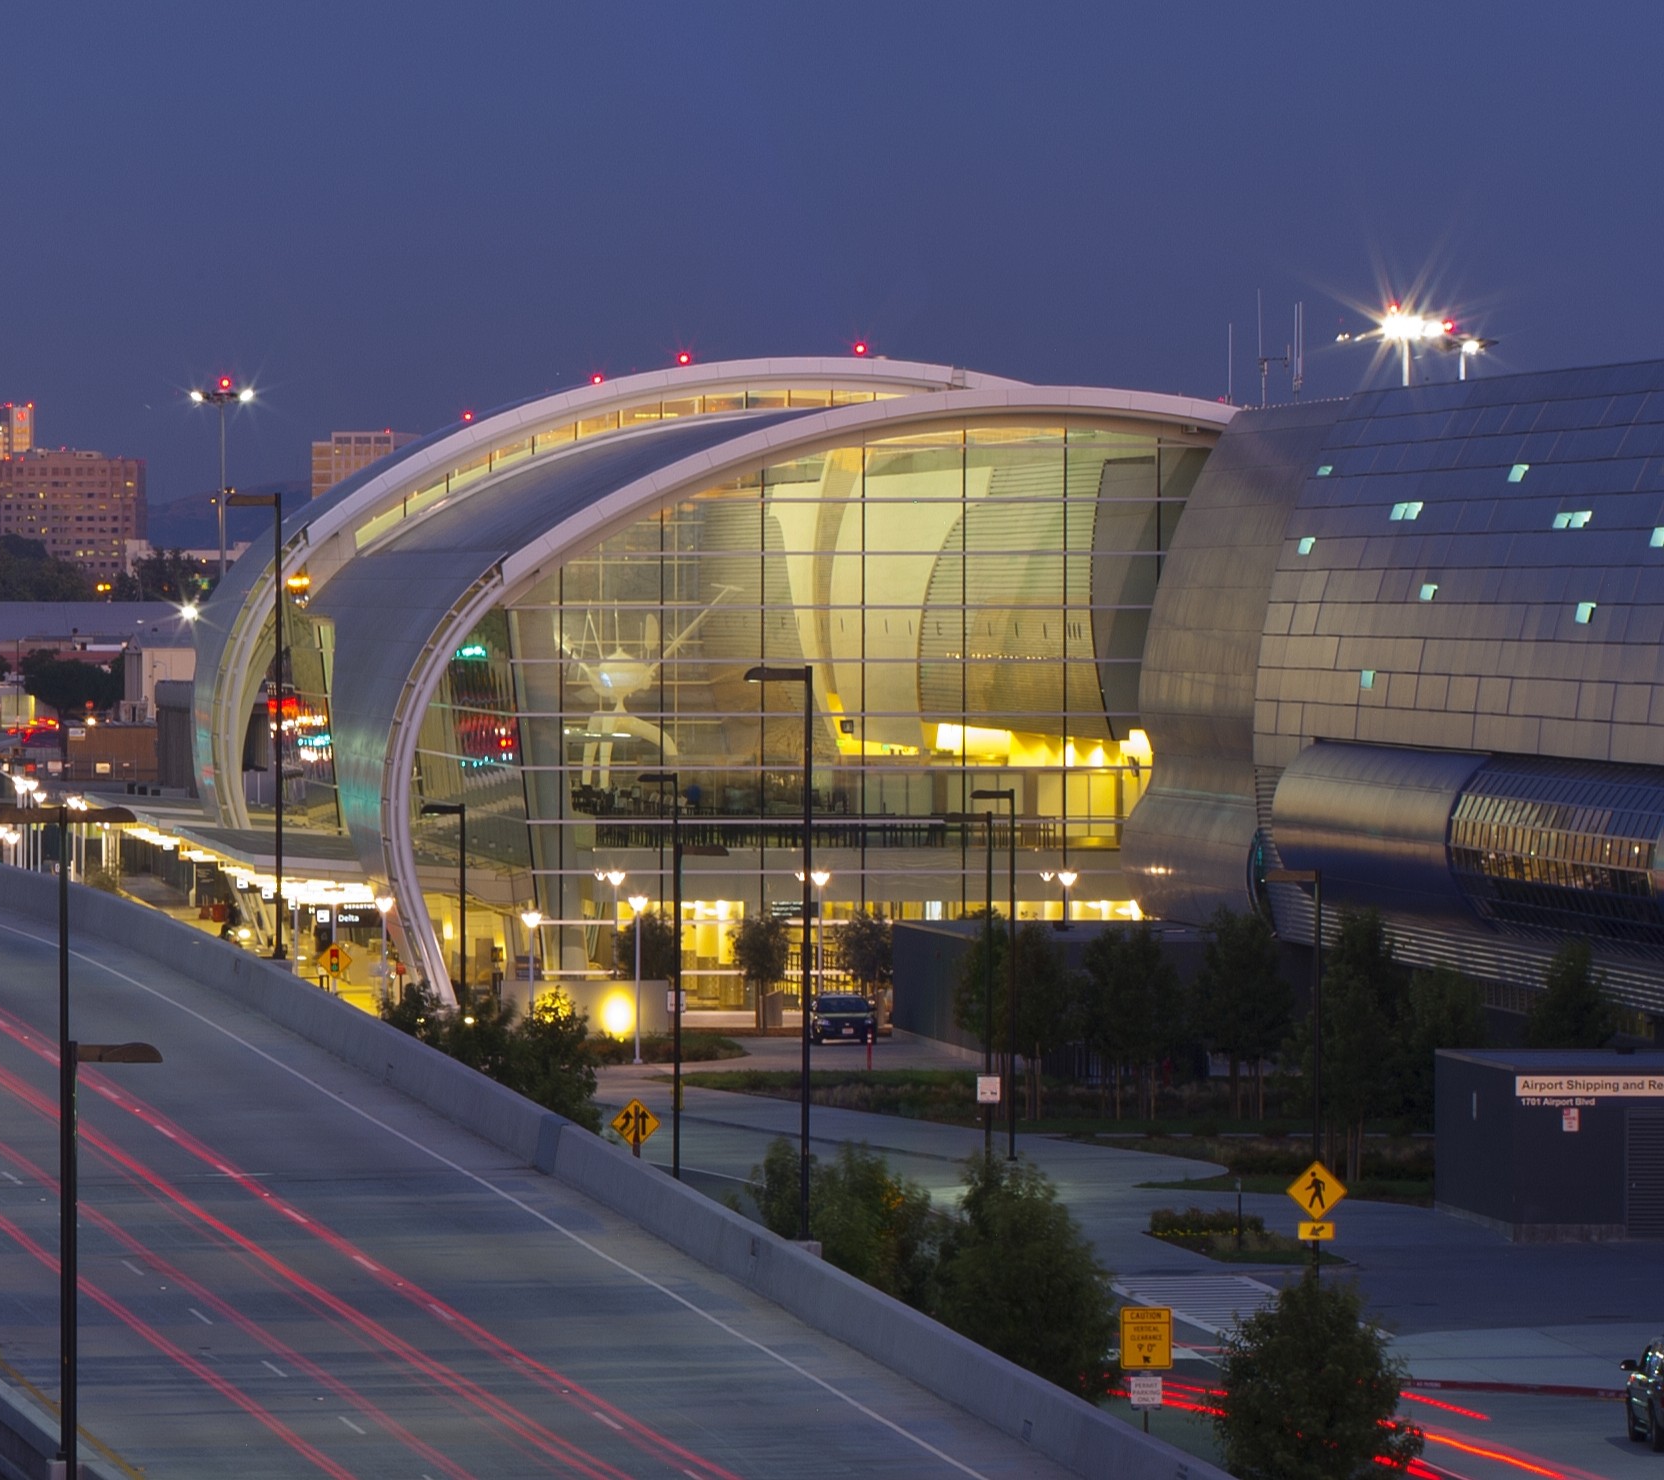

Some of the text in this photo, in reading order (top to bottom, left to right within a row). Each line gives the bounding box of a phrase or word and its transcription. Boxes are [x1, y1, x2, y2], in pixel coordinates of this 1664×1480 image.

[338, 914, 360, 922] Delta
[1522, 1080, 1563, 1092] Airport
[1566, 1080, 1619, 1092] Shipping
[1622, 1080, 1645, 1090] and
[1521, 1098, 1596, 1107] 1701 Airport Blvd
[1130, 1312, 1162, 1320] CAUTION
